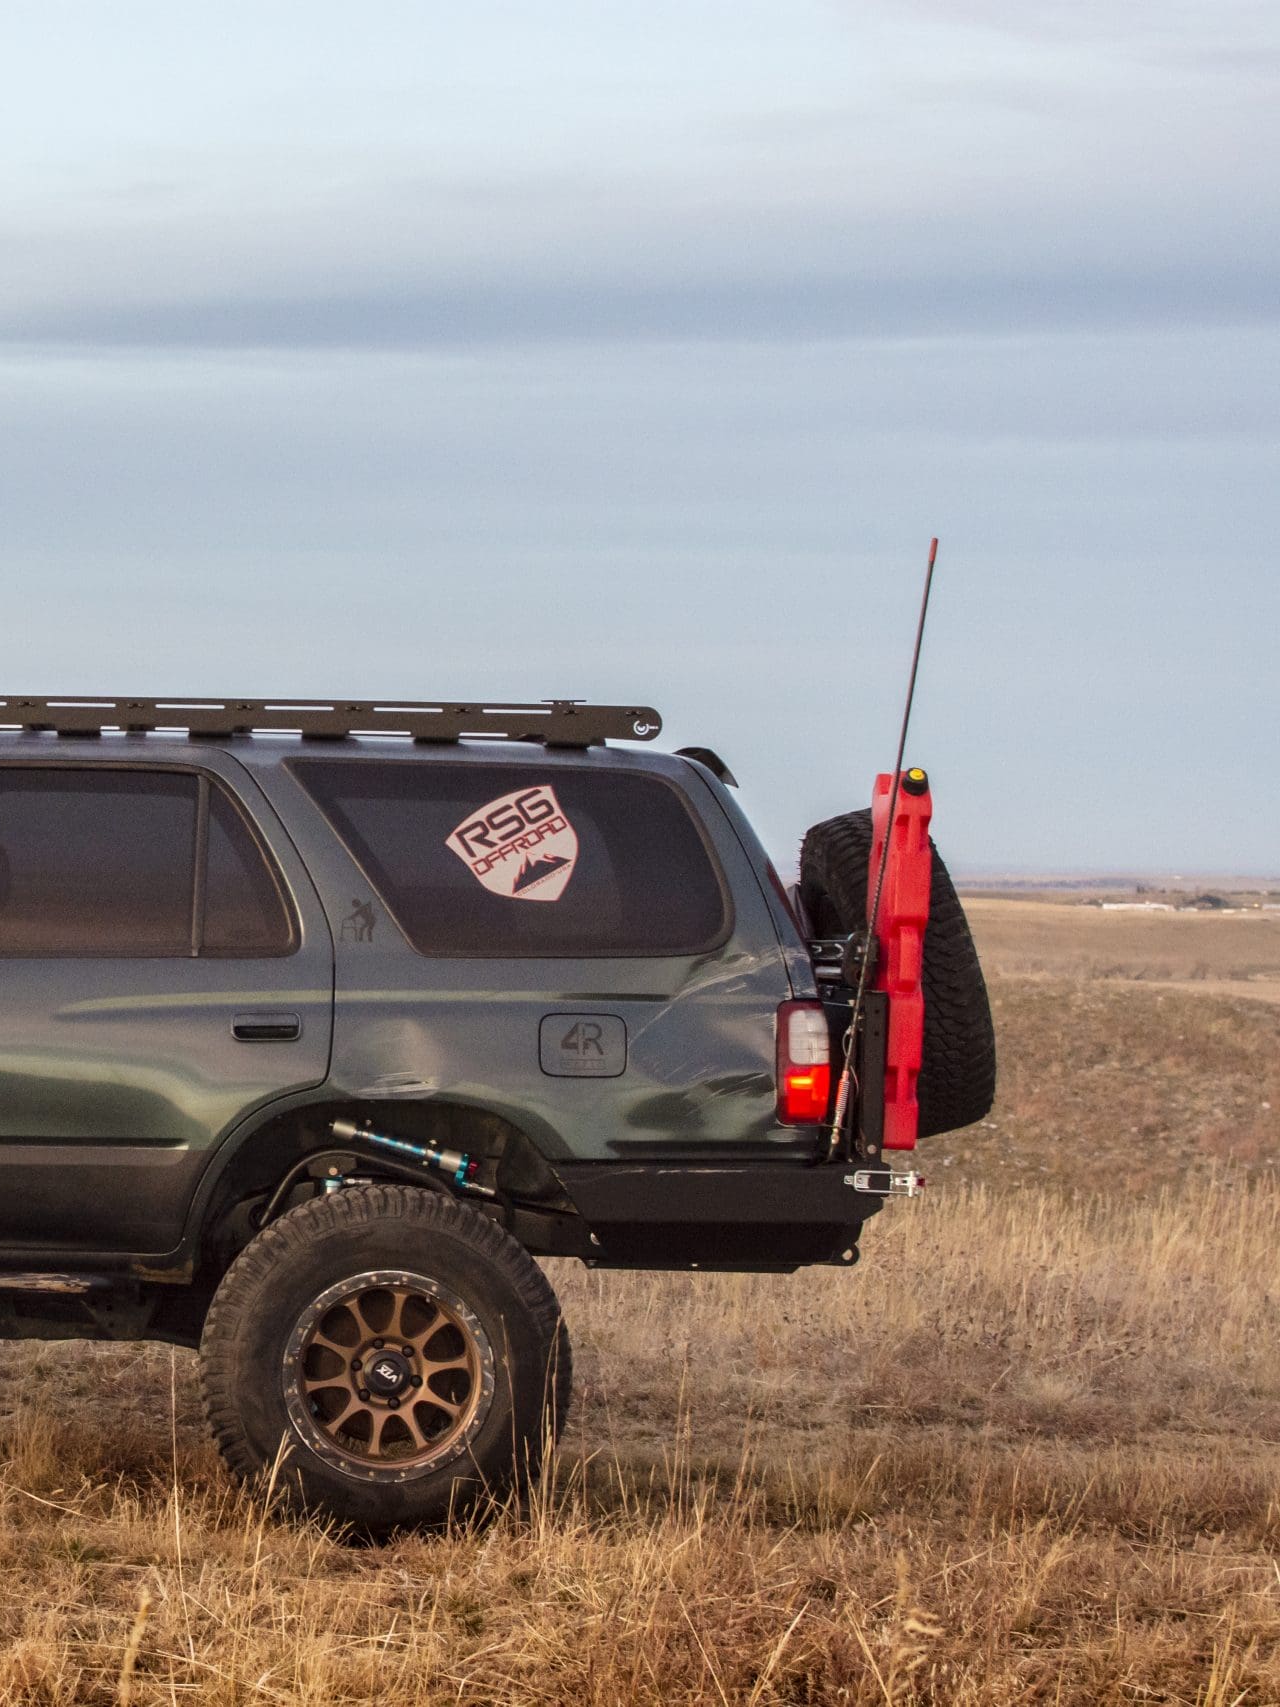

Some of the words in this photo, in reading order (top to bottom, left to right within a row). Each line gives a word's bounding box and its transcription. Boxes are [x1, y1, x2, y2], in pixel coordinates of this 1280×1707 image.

[455, 788, 555, 858] RSG
[471, 815, 567, 876] OFFROAD
[561, 1022, 604, 1055] 4R
